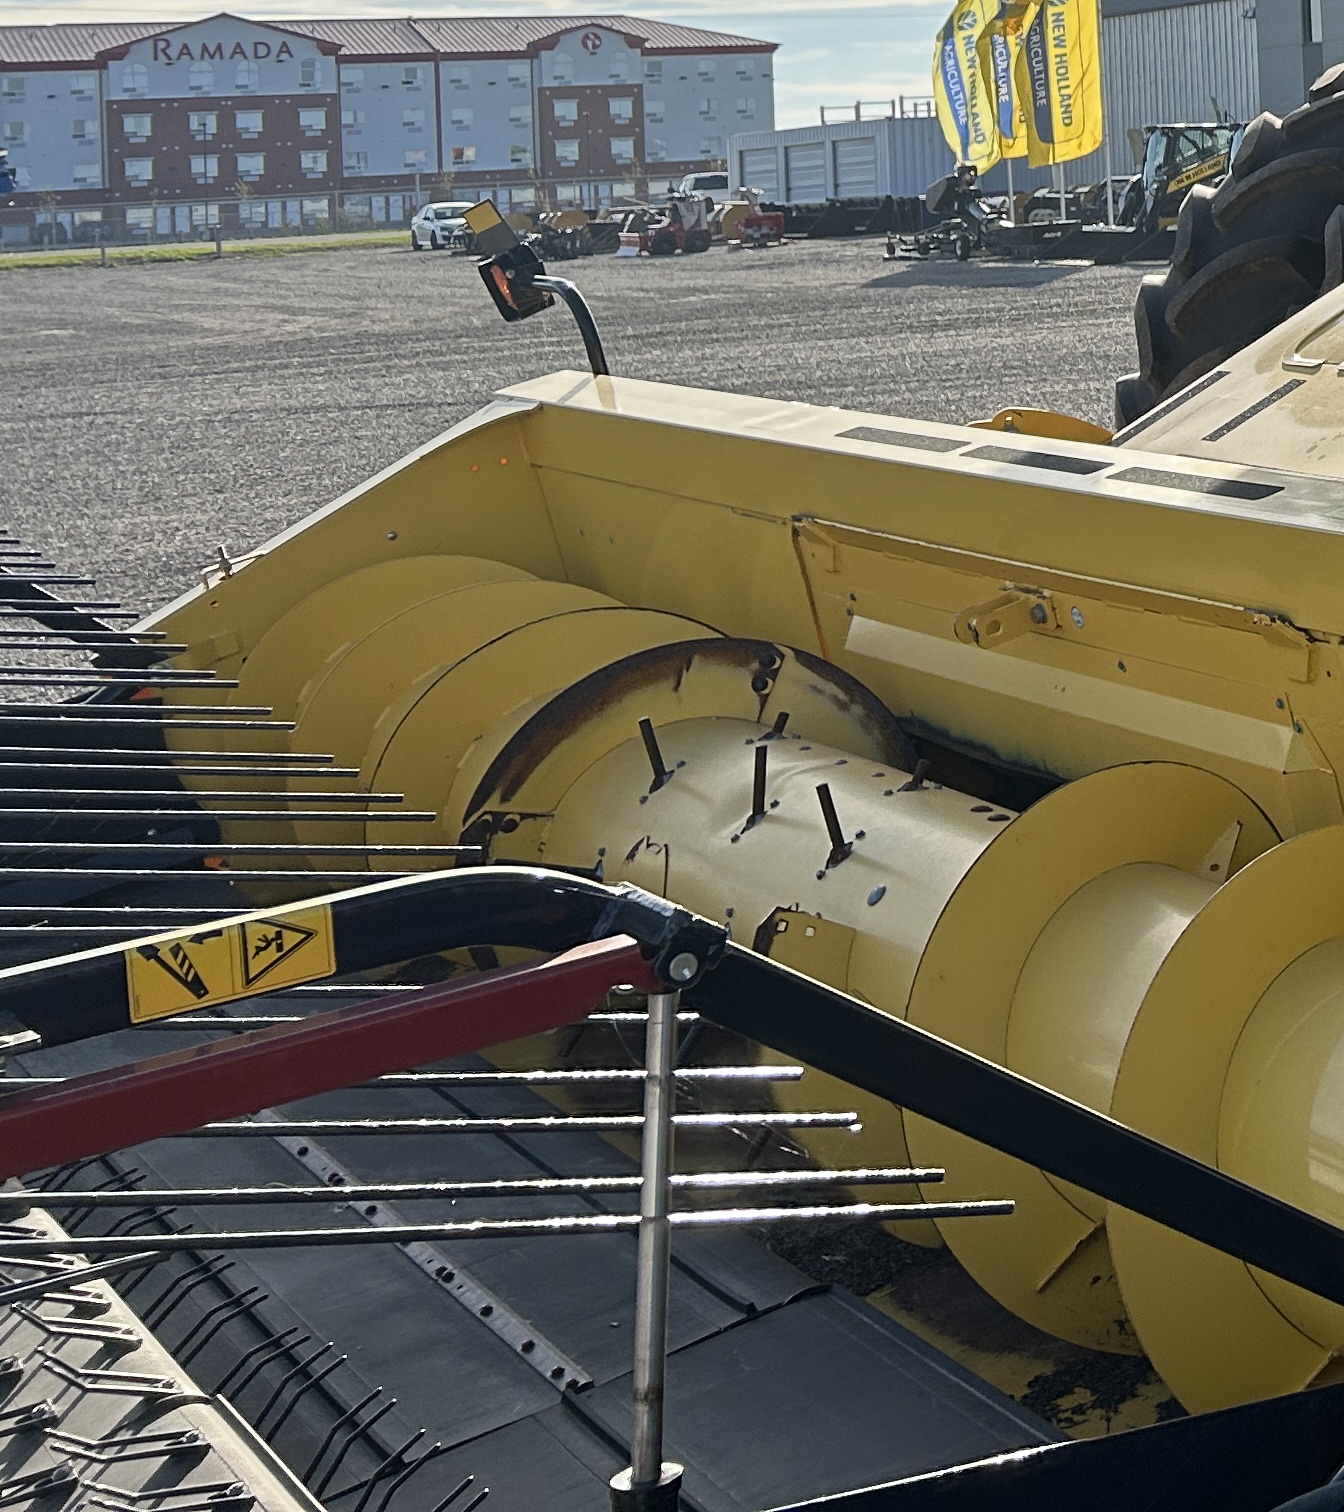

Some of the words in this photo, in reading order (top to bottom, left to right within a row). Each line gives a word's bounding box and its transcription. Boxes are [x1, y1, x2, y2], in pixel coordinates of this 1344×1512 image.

[1051, 11, 1067, 48] NEW
[152, 38, 294, 62] RAMADA
[962, 33, 977, 69] NEW
[944, 44, 968, 126] AGRICULTURE
[1054, 52, 1073, 127] HOLLAND
